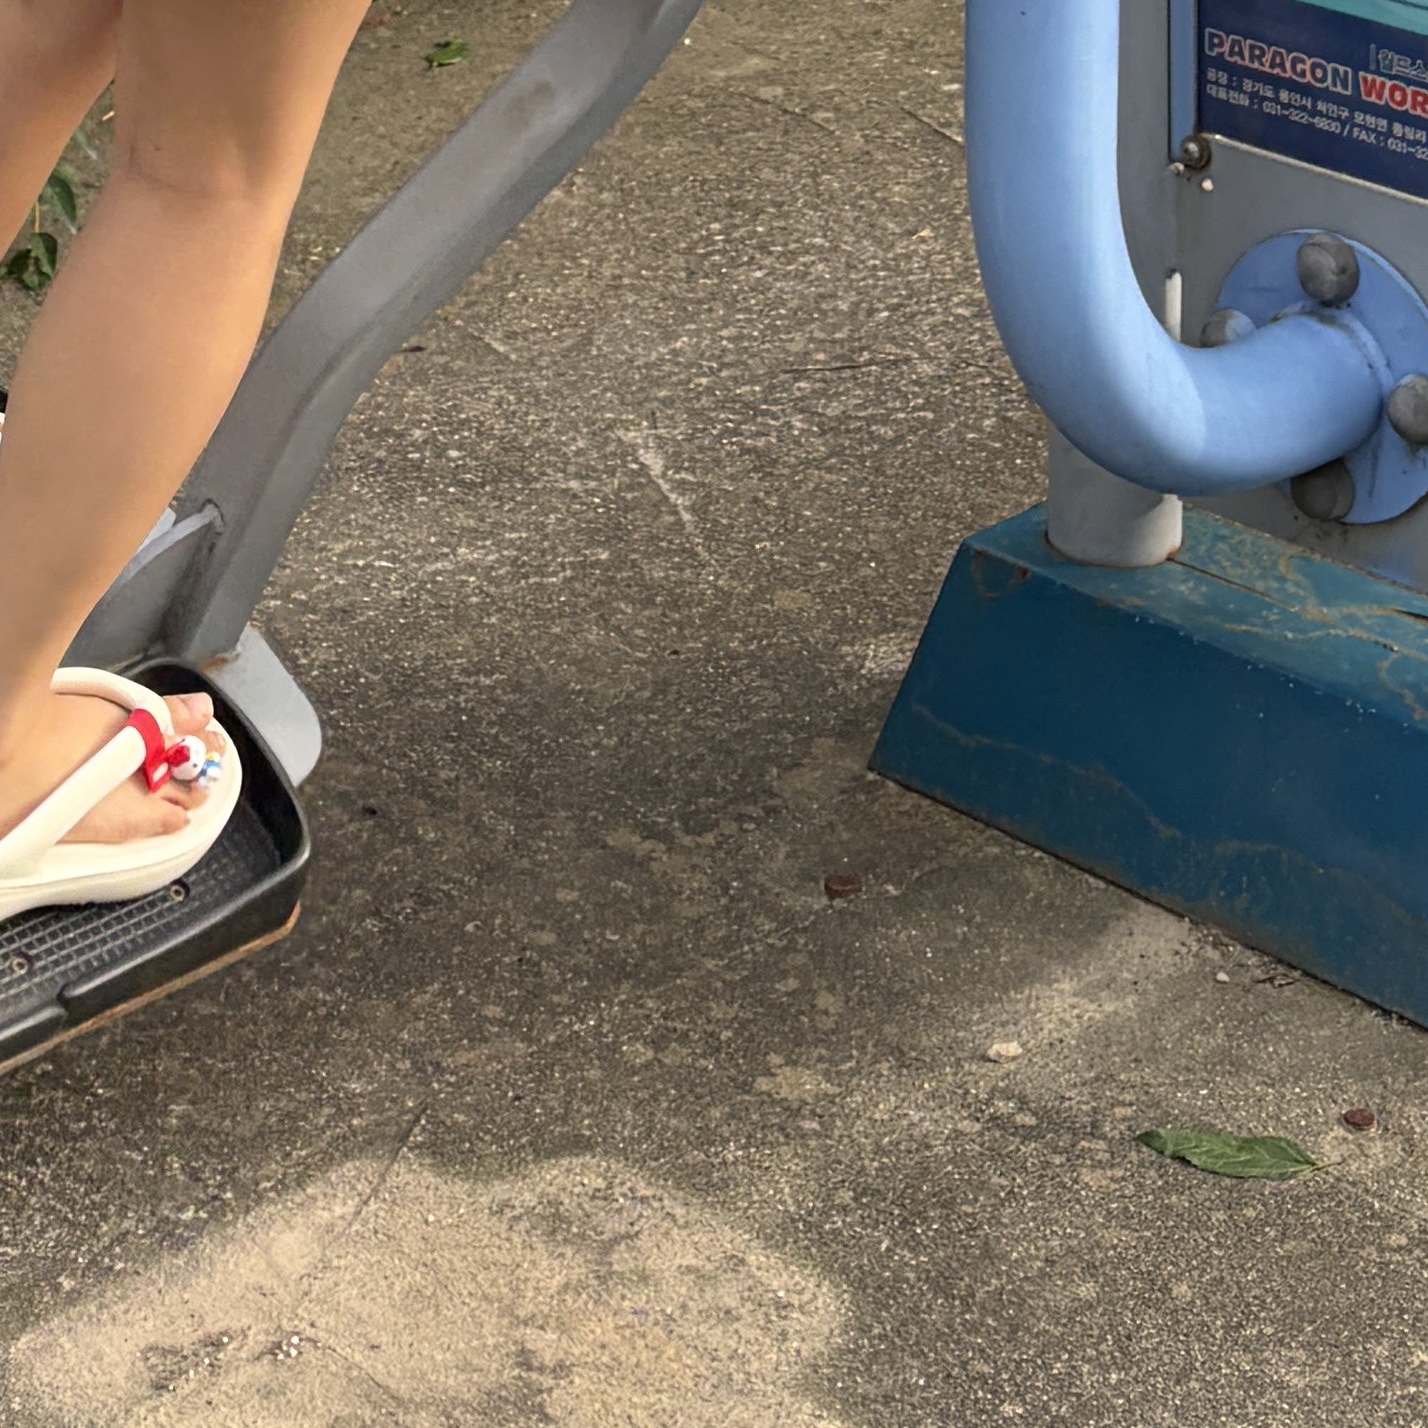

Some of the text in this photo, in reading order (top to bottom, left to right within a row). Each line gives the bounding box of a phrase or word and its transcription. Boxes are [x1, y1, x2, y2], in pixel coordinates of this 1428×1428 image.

[1204, 27, 1353, 97] PARAGON
[1241, 78, 1276, 100] 경기도
[1351, 125, 1378, 147] FAX
